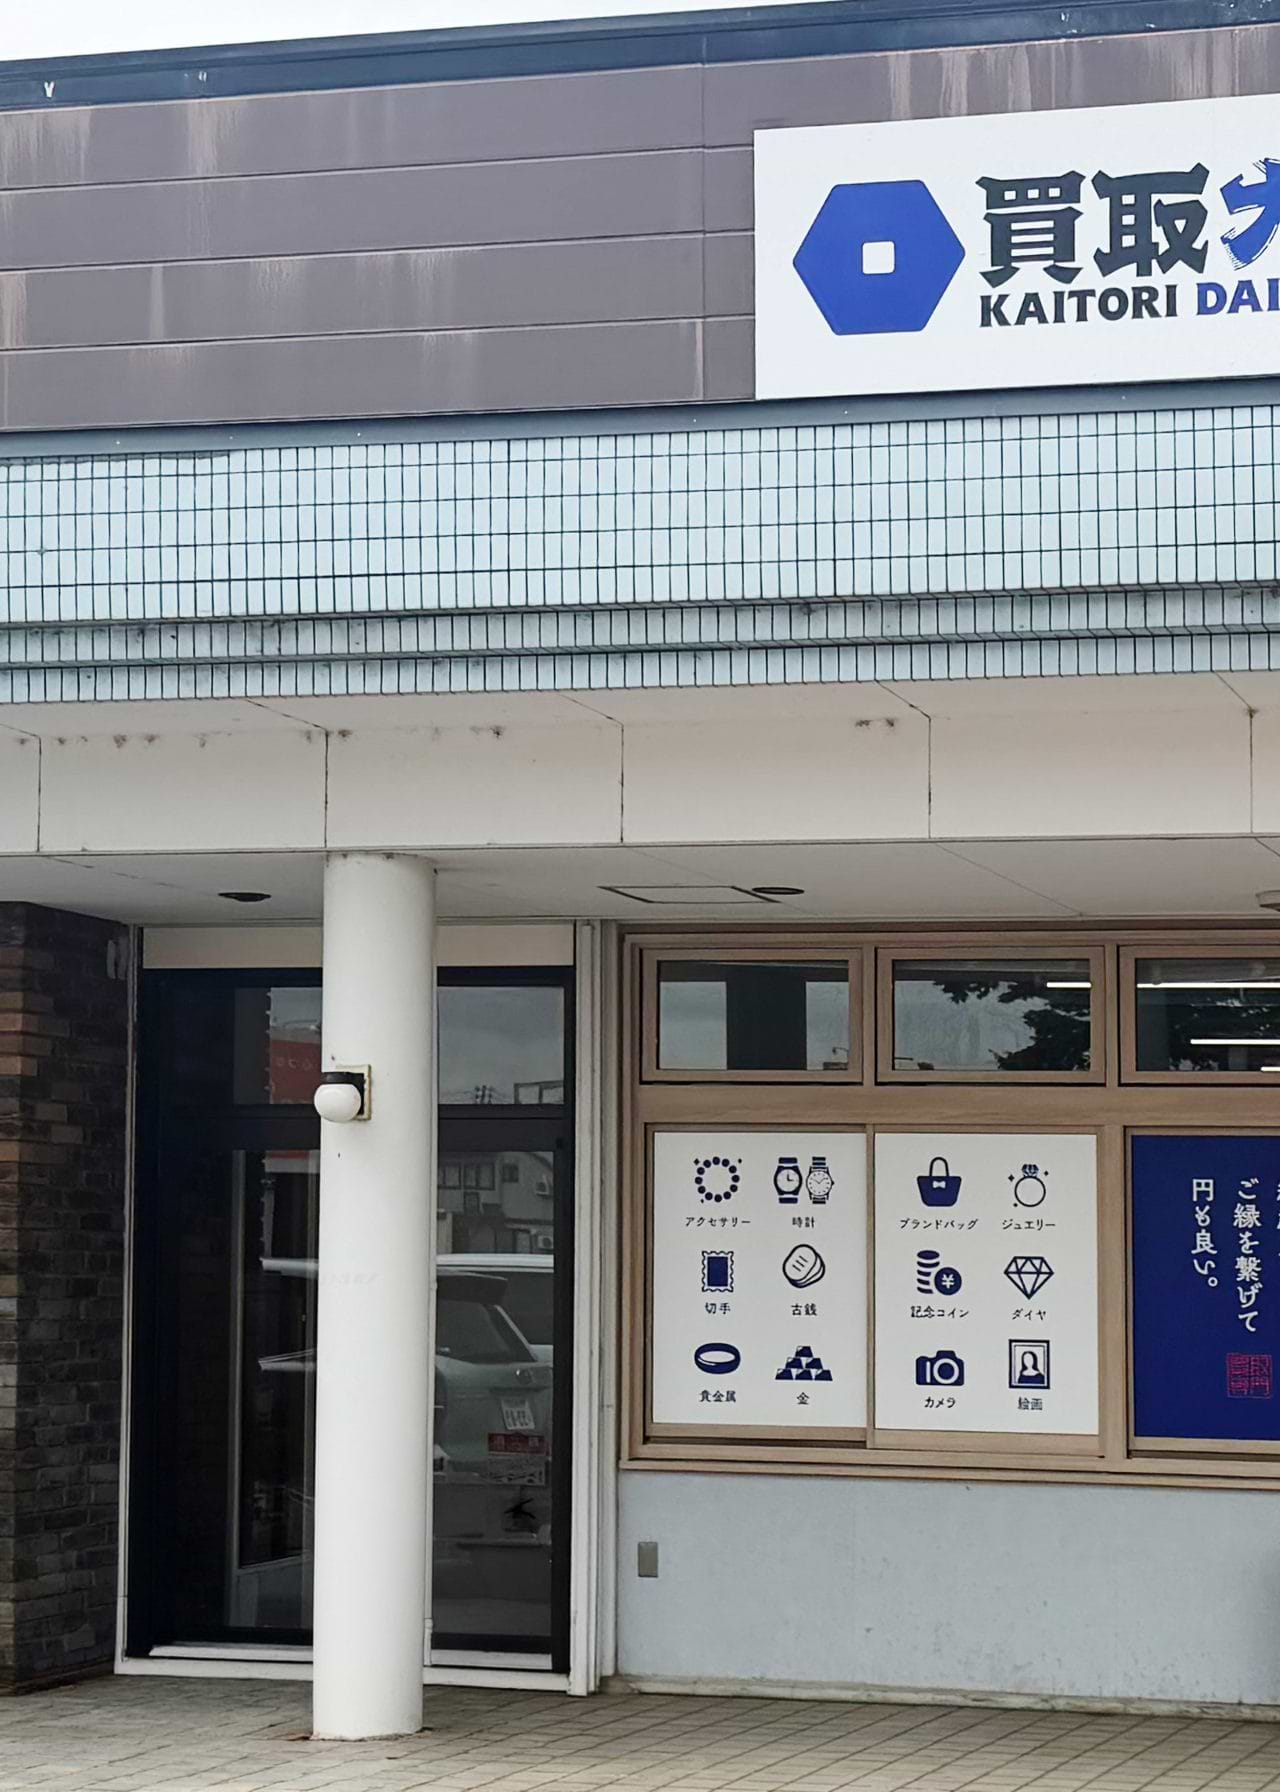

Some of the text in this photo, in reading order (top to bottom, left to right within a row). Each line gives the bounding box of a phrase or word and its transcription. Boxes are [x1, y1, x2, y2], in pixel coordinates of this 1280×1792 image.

[979, 284, 1178, 328] KAITORI
[685, 1216, 751, 1228] アクセサリー
[792, 1216, 815, 1228] 時計
[900, 1217, 979, 1230] ブランドバッグ
[1002, 1218, 1056, 1231] ジュエリー
[1190, 1178, 1218, 1287] 円も良い。
[1233, 1177, 1263, 1332] ご縁を繋げて
[704, 1302, 731, 1315] 切手
[791, 1303, 818, 1316] 古銭
[910, 1305, 970, 1319] 記念コイン
[1012, 1308, 1047, 1321] ダイヤ
[699, 1389, 737, 1404] 貴金属
[796, 1391, 810, 1406] 金
[924, 1396, 957, 1410] カメラ
[1017, 1396, 1044, 1411] 絵画
